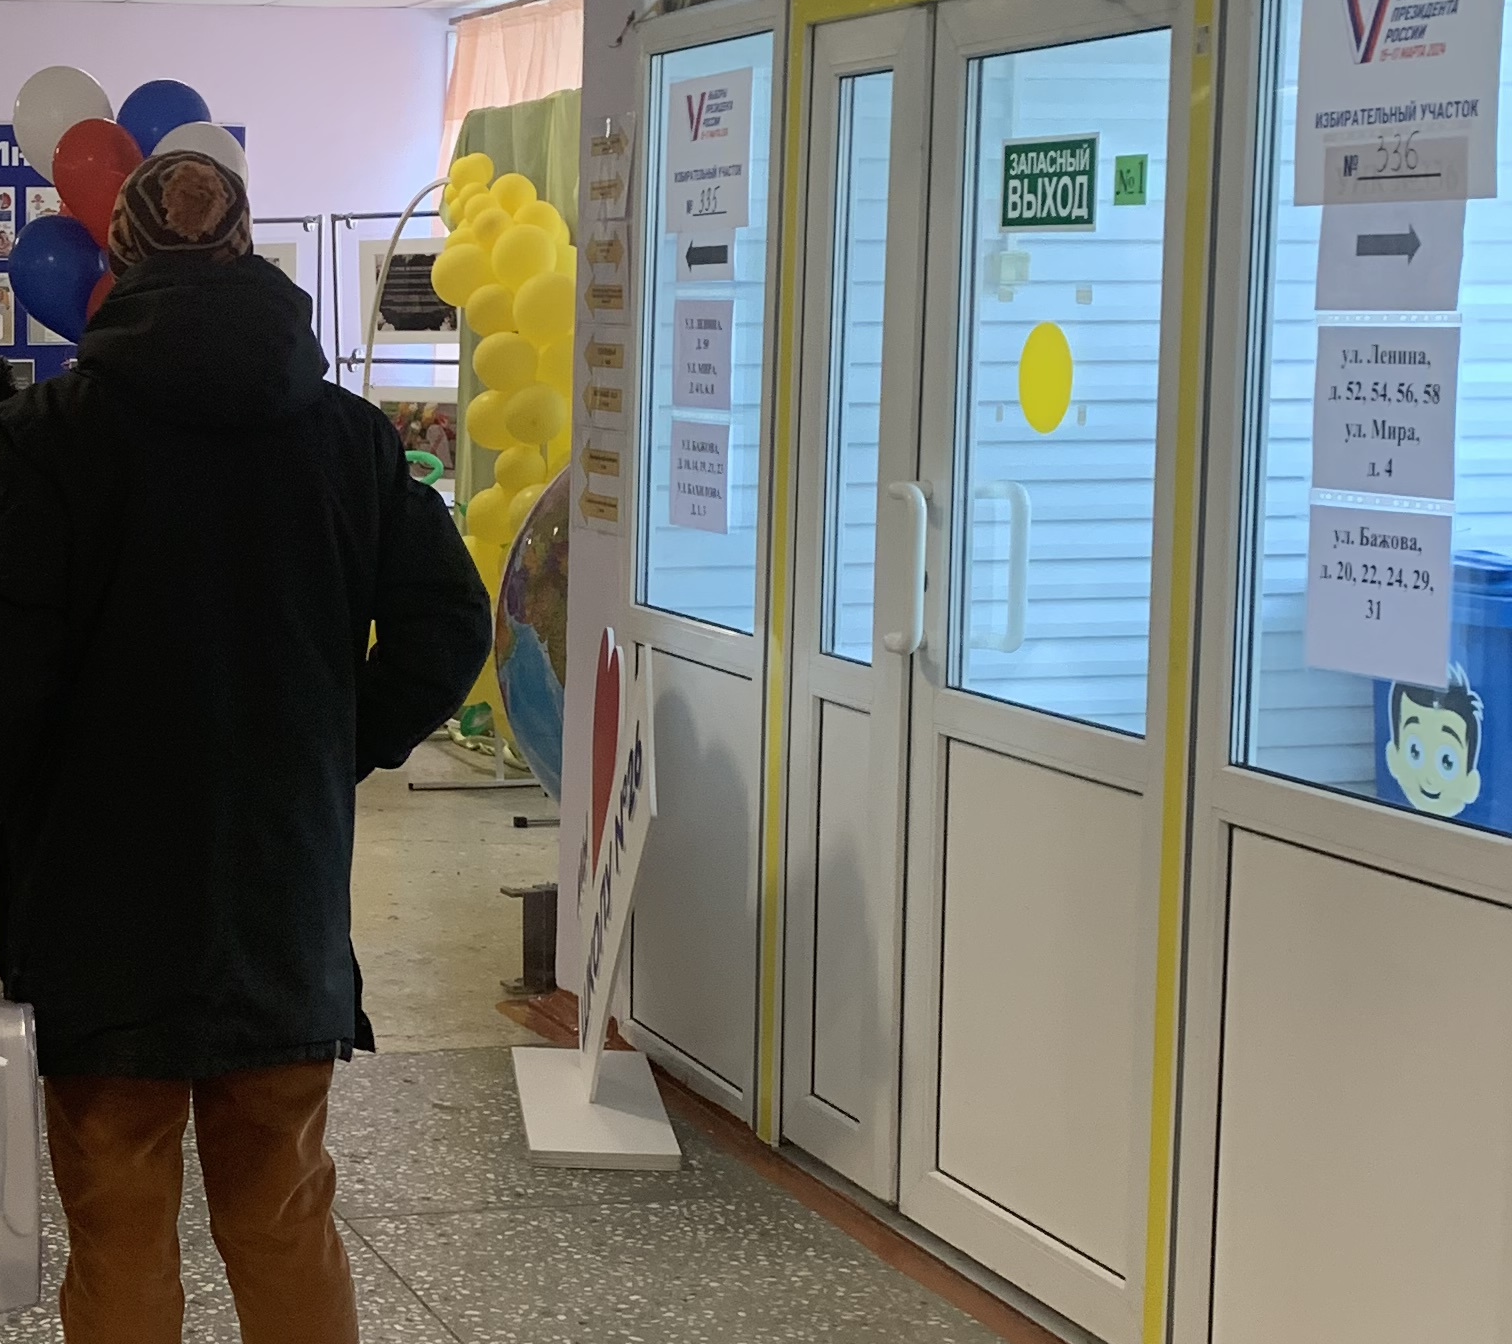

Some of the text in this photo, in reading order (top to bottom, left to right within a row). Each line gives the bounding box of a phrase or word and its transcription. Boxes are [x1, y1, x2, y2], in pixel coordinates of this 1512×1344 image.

[1390, 0, 1460, 22] ПРЕЗИДЕНТА
[1384, 24, 1428, 43] РОССИИ
[1315, 99, 1480, 129] ИЗБИРАТЕЛЬНЫЙ УЧАСТОК
[1009, 144, 1090, 176] ЗАПАСНЫЙ
[1376, 130, 1420, 173] 336
[1007, 175, 1089, 220] ВЫХОД
[1340, 344, 1432, 369] ул. Ленина,
[1328, 381, 1441, 407] д. 52, 54, 56, 58
[1344, 419, 1420, 447] ул. Мира,
[1367, 458, 1393, 477] д. 4
[1333, 526, 1422, 555] ул. Бажова,
[1320, 561, 1434, 595] д. 20, 22, 24, 29,
[1365, 599, 1381, 620] 31
